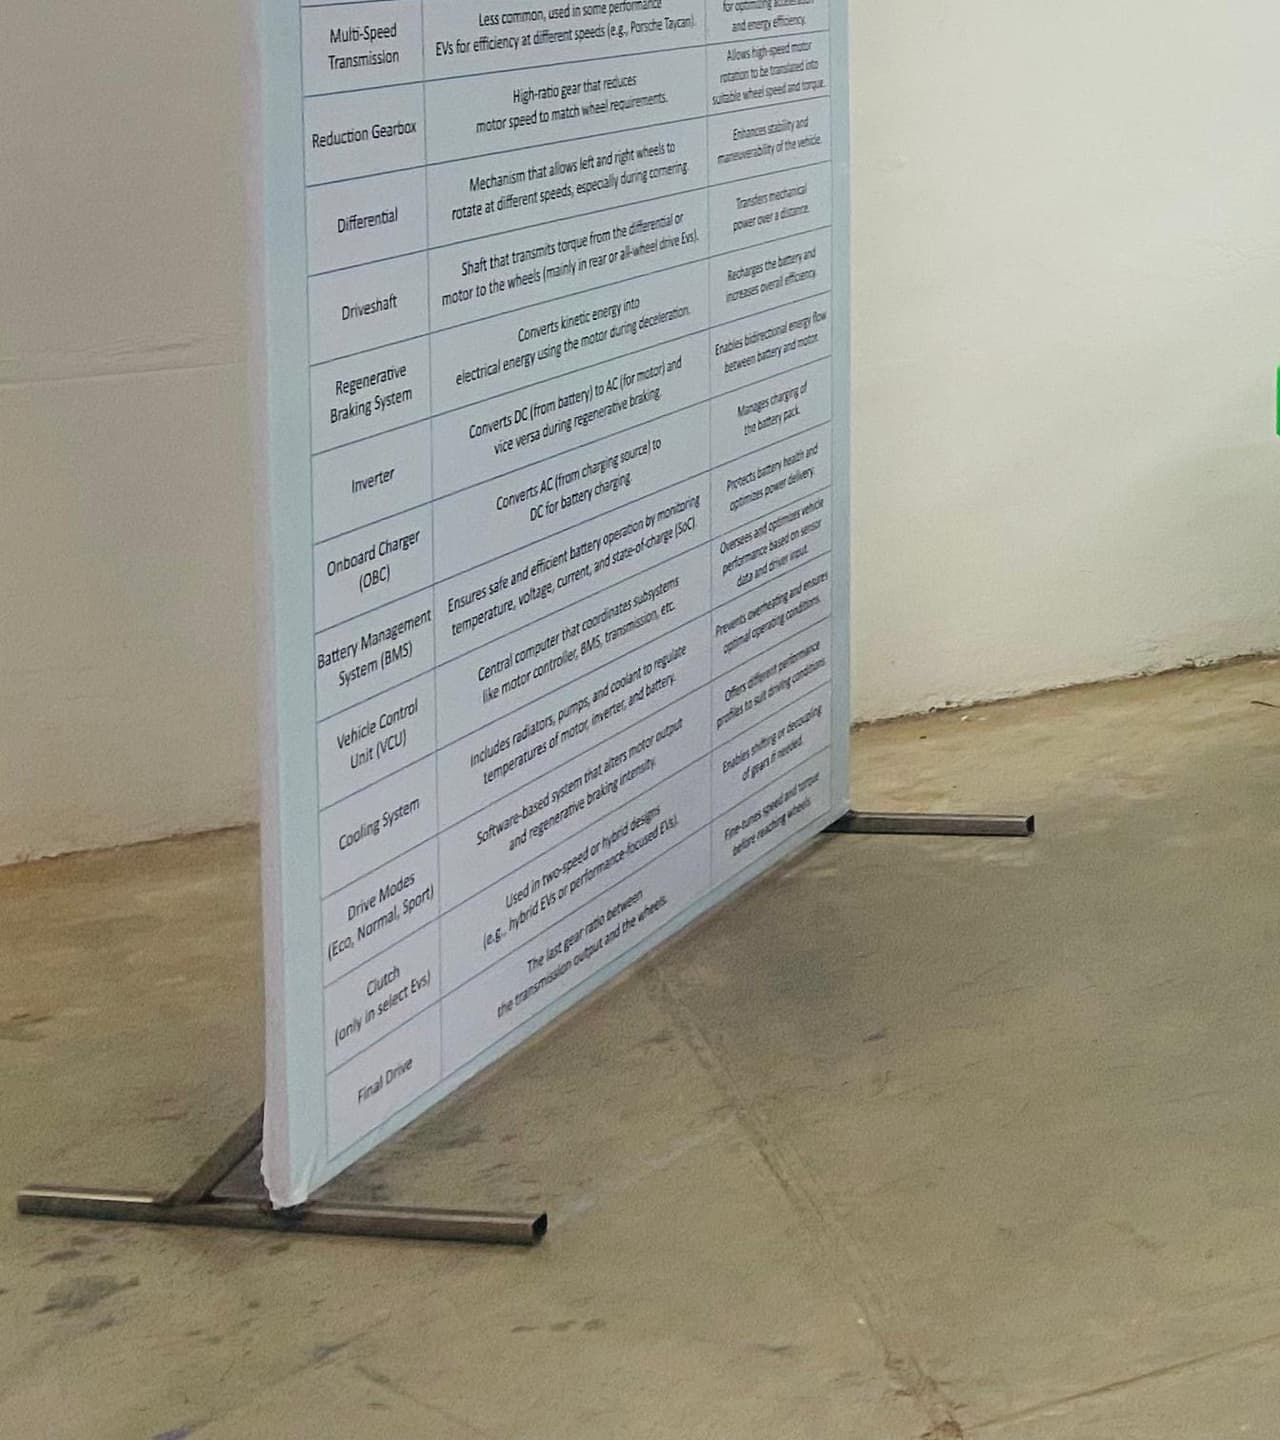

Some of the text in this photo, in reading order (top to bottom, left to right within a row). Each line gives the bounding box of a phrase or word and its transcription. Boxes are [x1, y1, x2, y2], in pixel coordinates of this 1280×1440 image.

[329, 23, 397, 43] Multi-Speed
[328, 51, 399, 69] Transmission
[312, 123, 417, 149] Reduction Gearbox
[337, 208, 398, 233] Differential
[342, 295, 398, 321] Driveshaft
[335, 365, 407, 395] Regenerative
[330, 389, 412, 422] Braking System
[352, 468, 395, 493] Inverter
[327, 532, 420, 576] Onboard Charger
[359, 563, 391, 592] (OBC)
[317, 610, 432, 668] Battery Management
[338, 641, 413, 686] System (BMS)
[337, 697, 418, 749] Vehicle Control
[350, 730, 407, 769] Unit (VCU)
[339, 799, 420, 850] Cooling System
[348, 874, 415, 920] Drive Modes
[328, 886, 434, 961] (Eco, Normal, Sport)
[366, 964, 400, 996] Clutch
[334, 969, 431, 1045] (only in select Evs)
[357, 1058, 413, 1103] Final Drive
